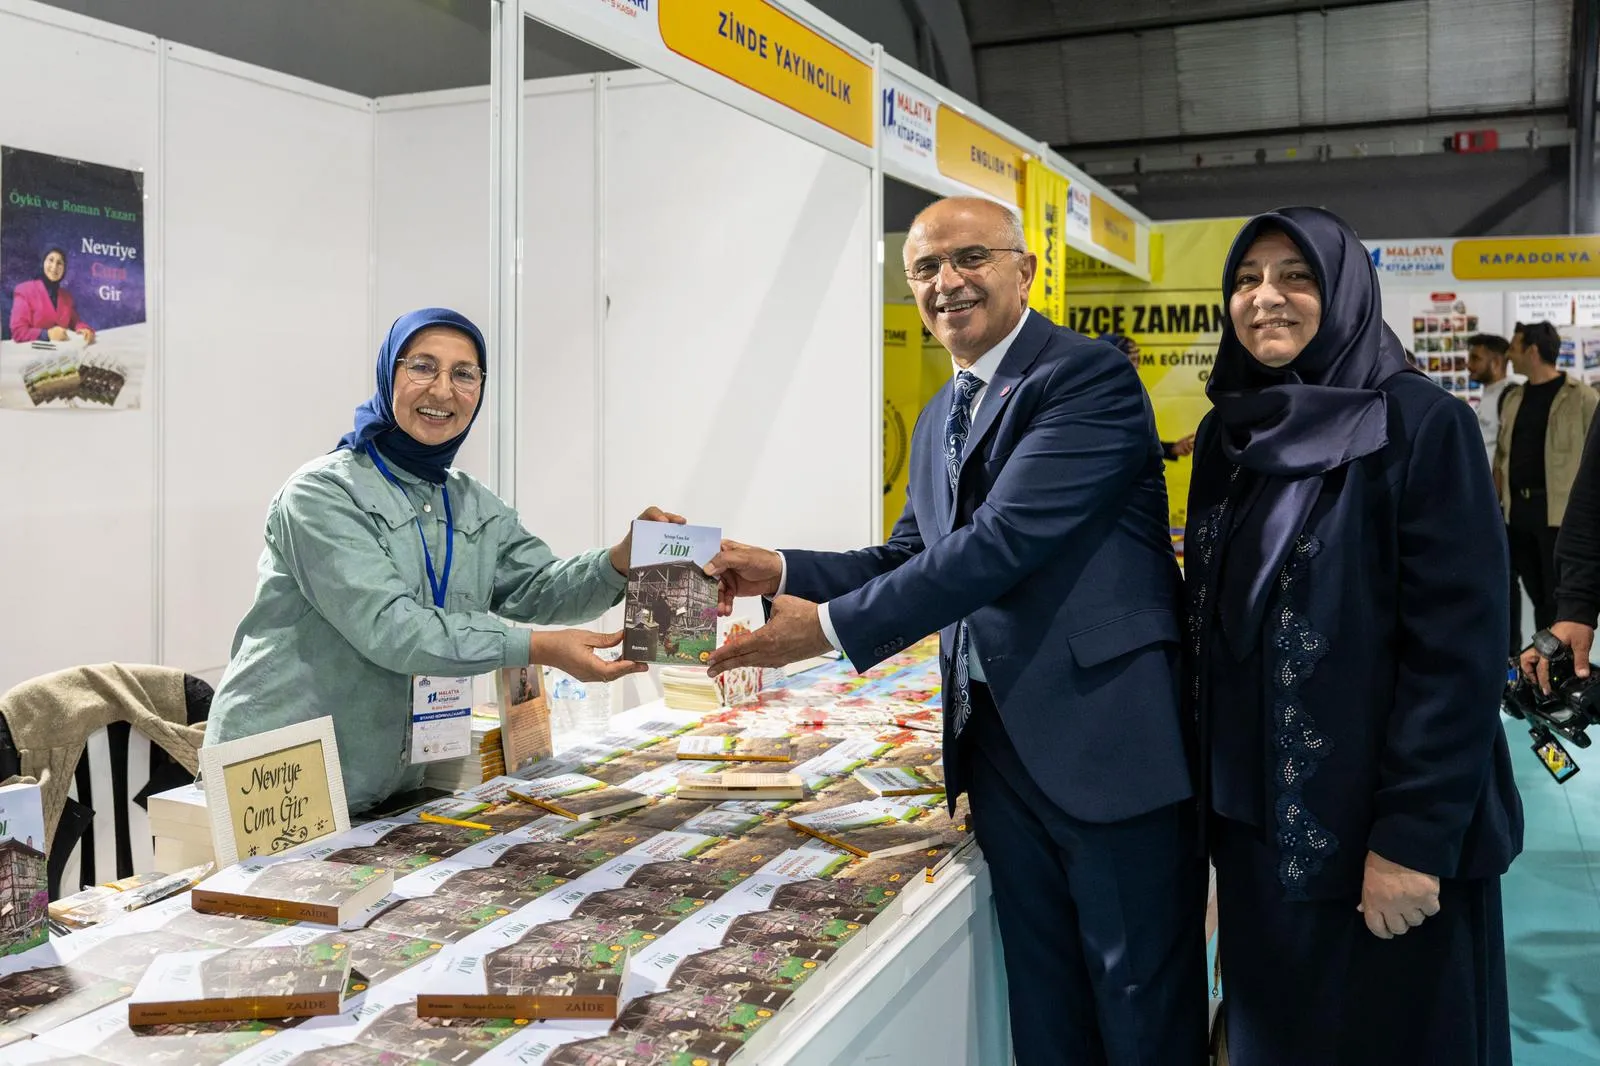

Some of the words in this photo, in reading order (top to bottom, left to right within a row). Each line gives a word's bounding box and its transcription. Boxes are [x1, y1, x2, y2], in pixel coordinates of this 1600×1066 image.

[718, 11, 768, 59] ZİNDE
[774, 42, 852, 104] YAYINCILIK
[897, 91, 931, 125] MALATYA
[971, 145, 1005, 176] ENGLISH
[9, 188, 42, 208] Öykü
[45, 199, 59, 210] ve
[63, 200, 100, 216] Roman
[104, 206, 137, 222] Yazarı
[81, 237, 137, 260] Nevriye
[1386, 245, 1444, 257] MALATYA
[1480, 252, 1590, 265] KAPADOKYA
[99, 285, 122, 302] Gir
[1068, 305, 1125, 335] İZCE
[1160, 351, 1216, 366] EĞİTİM
[241, 762, 303, 795] Nevriye
[244, 806, 276, 834] Cura
[280, 795, 318, 833] Gir
[286, 998, 327, 1010] ZAİDE
[566, 1001, 604, 1013] ZAİDE
